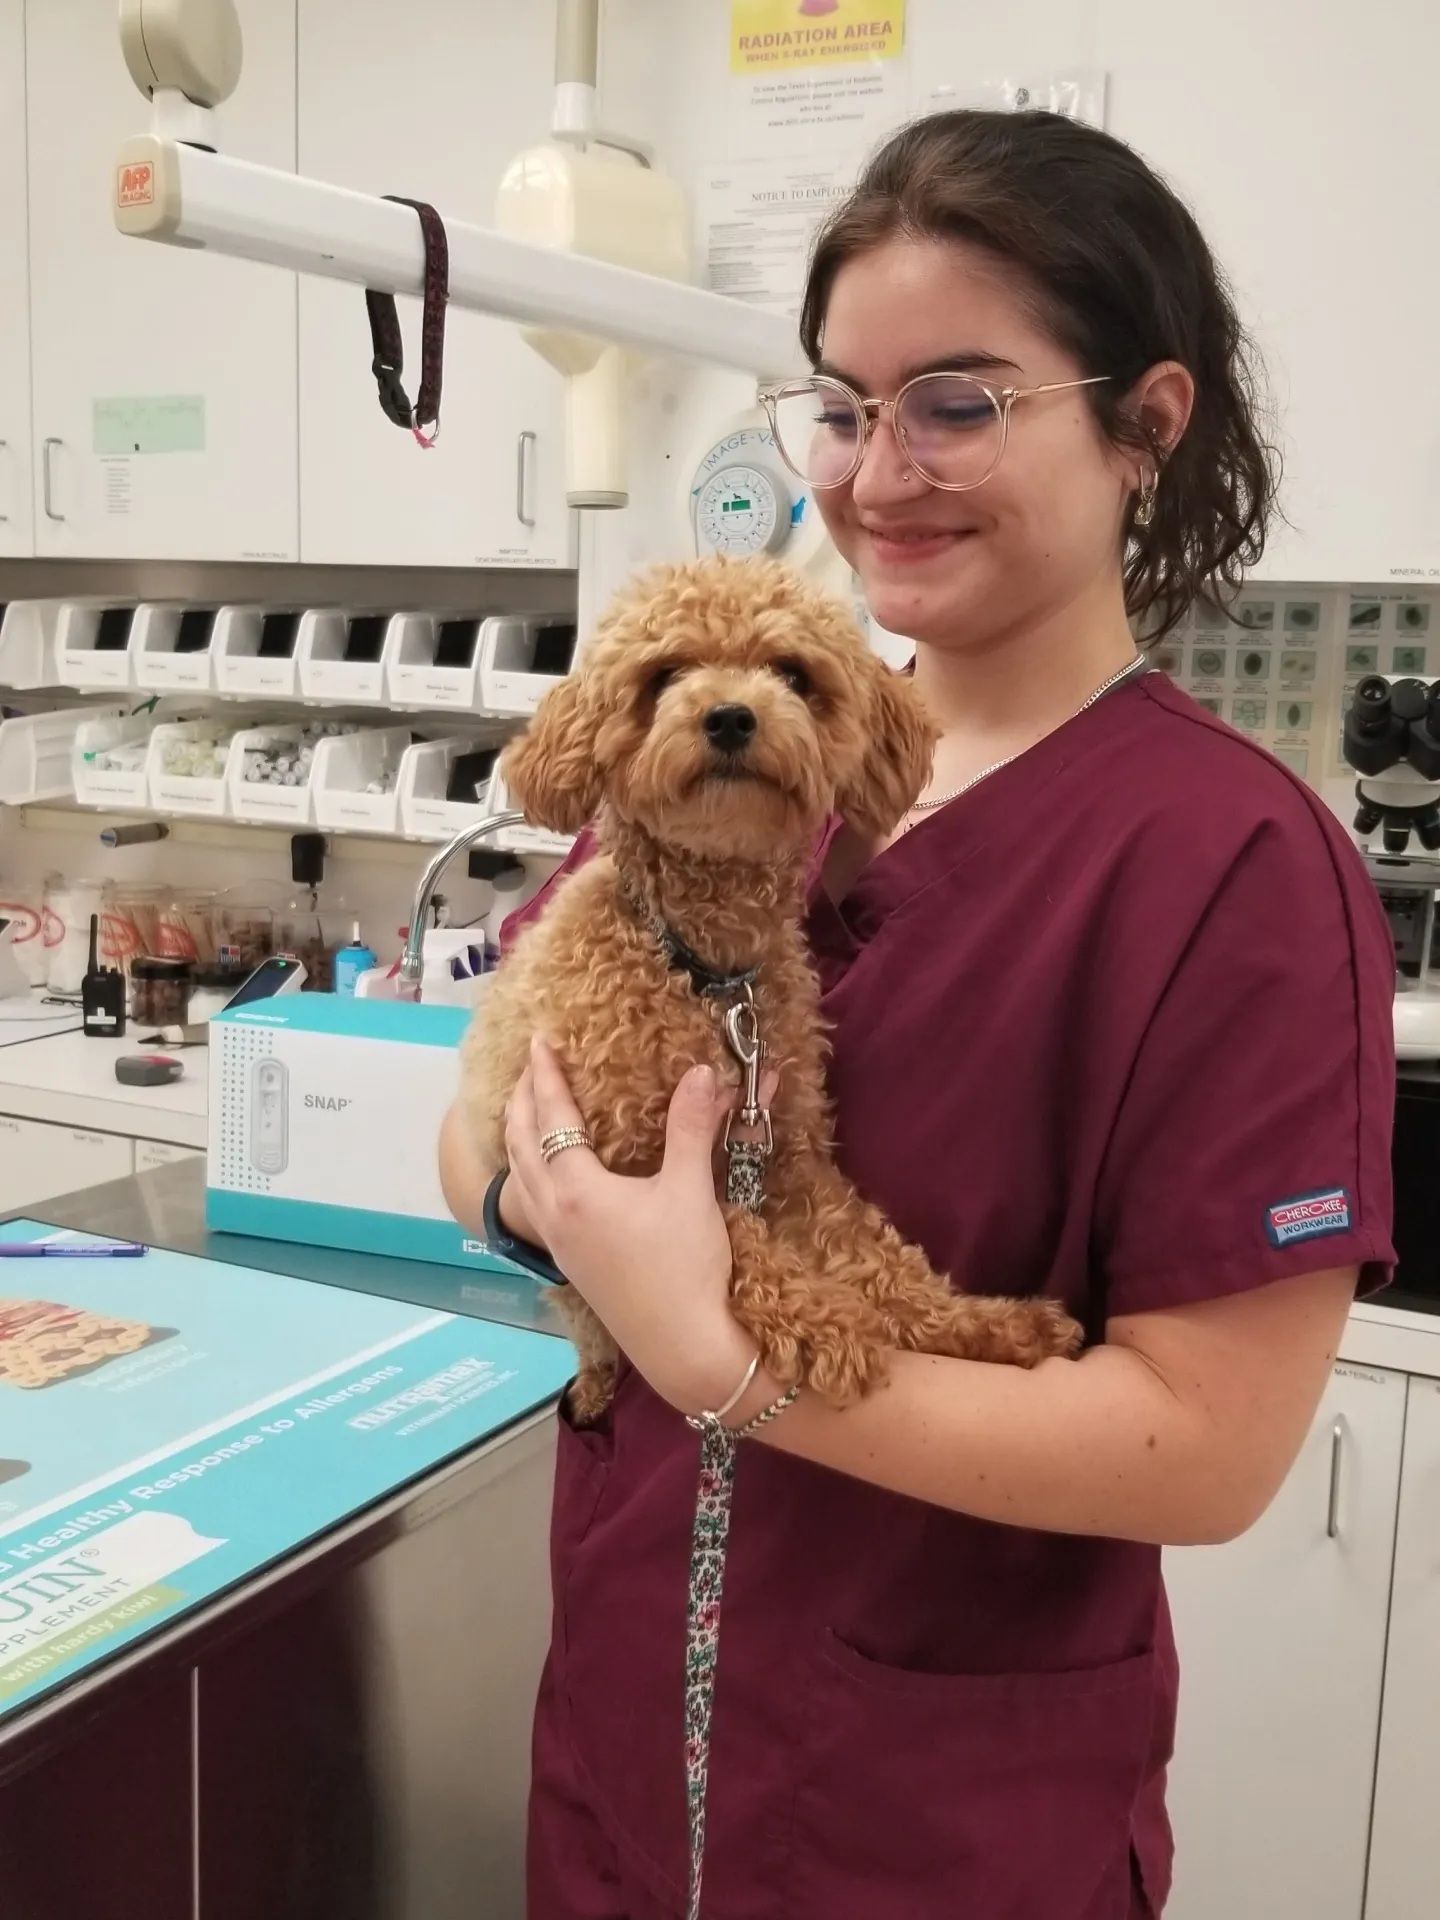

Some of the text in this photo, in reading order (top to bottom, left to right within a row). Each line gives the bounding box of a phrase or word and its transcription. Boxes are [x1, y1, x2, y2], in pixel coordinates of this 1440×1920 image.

[738, 20, 893, 49] RADIATION AREA
[746, 50, 779, 63] WHEN
[121, 166, 151, 192] AFP
[752, 191, 786, 202] NOTICE
[791, 189, 804, 199] TO
[304, 1094, 348, 1112] SNAP
[1275, 1199, 1342, 1224] CHEROKEE
[1282, 1215, 1344, 1235] WORKWEAR
[7, 1499, 133, 1559] Healthy
[129, 1434, 264, 1500] Response
[259, 1417, 295, 1435] to
[294, 1363, 404, 1420] Allergens
[2, 1652, 53, 1682] with
[51, 1618, 115, 1654] hardy
